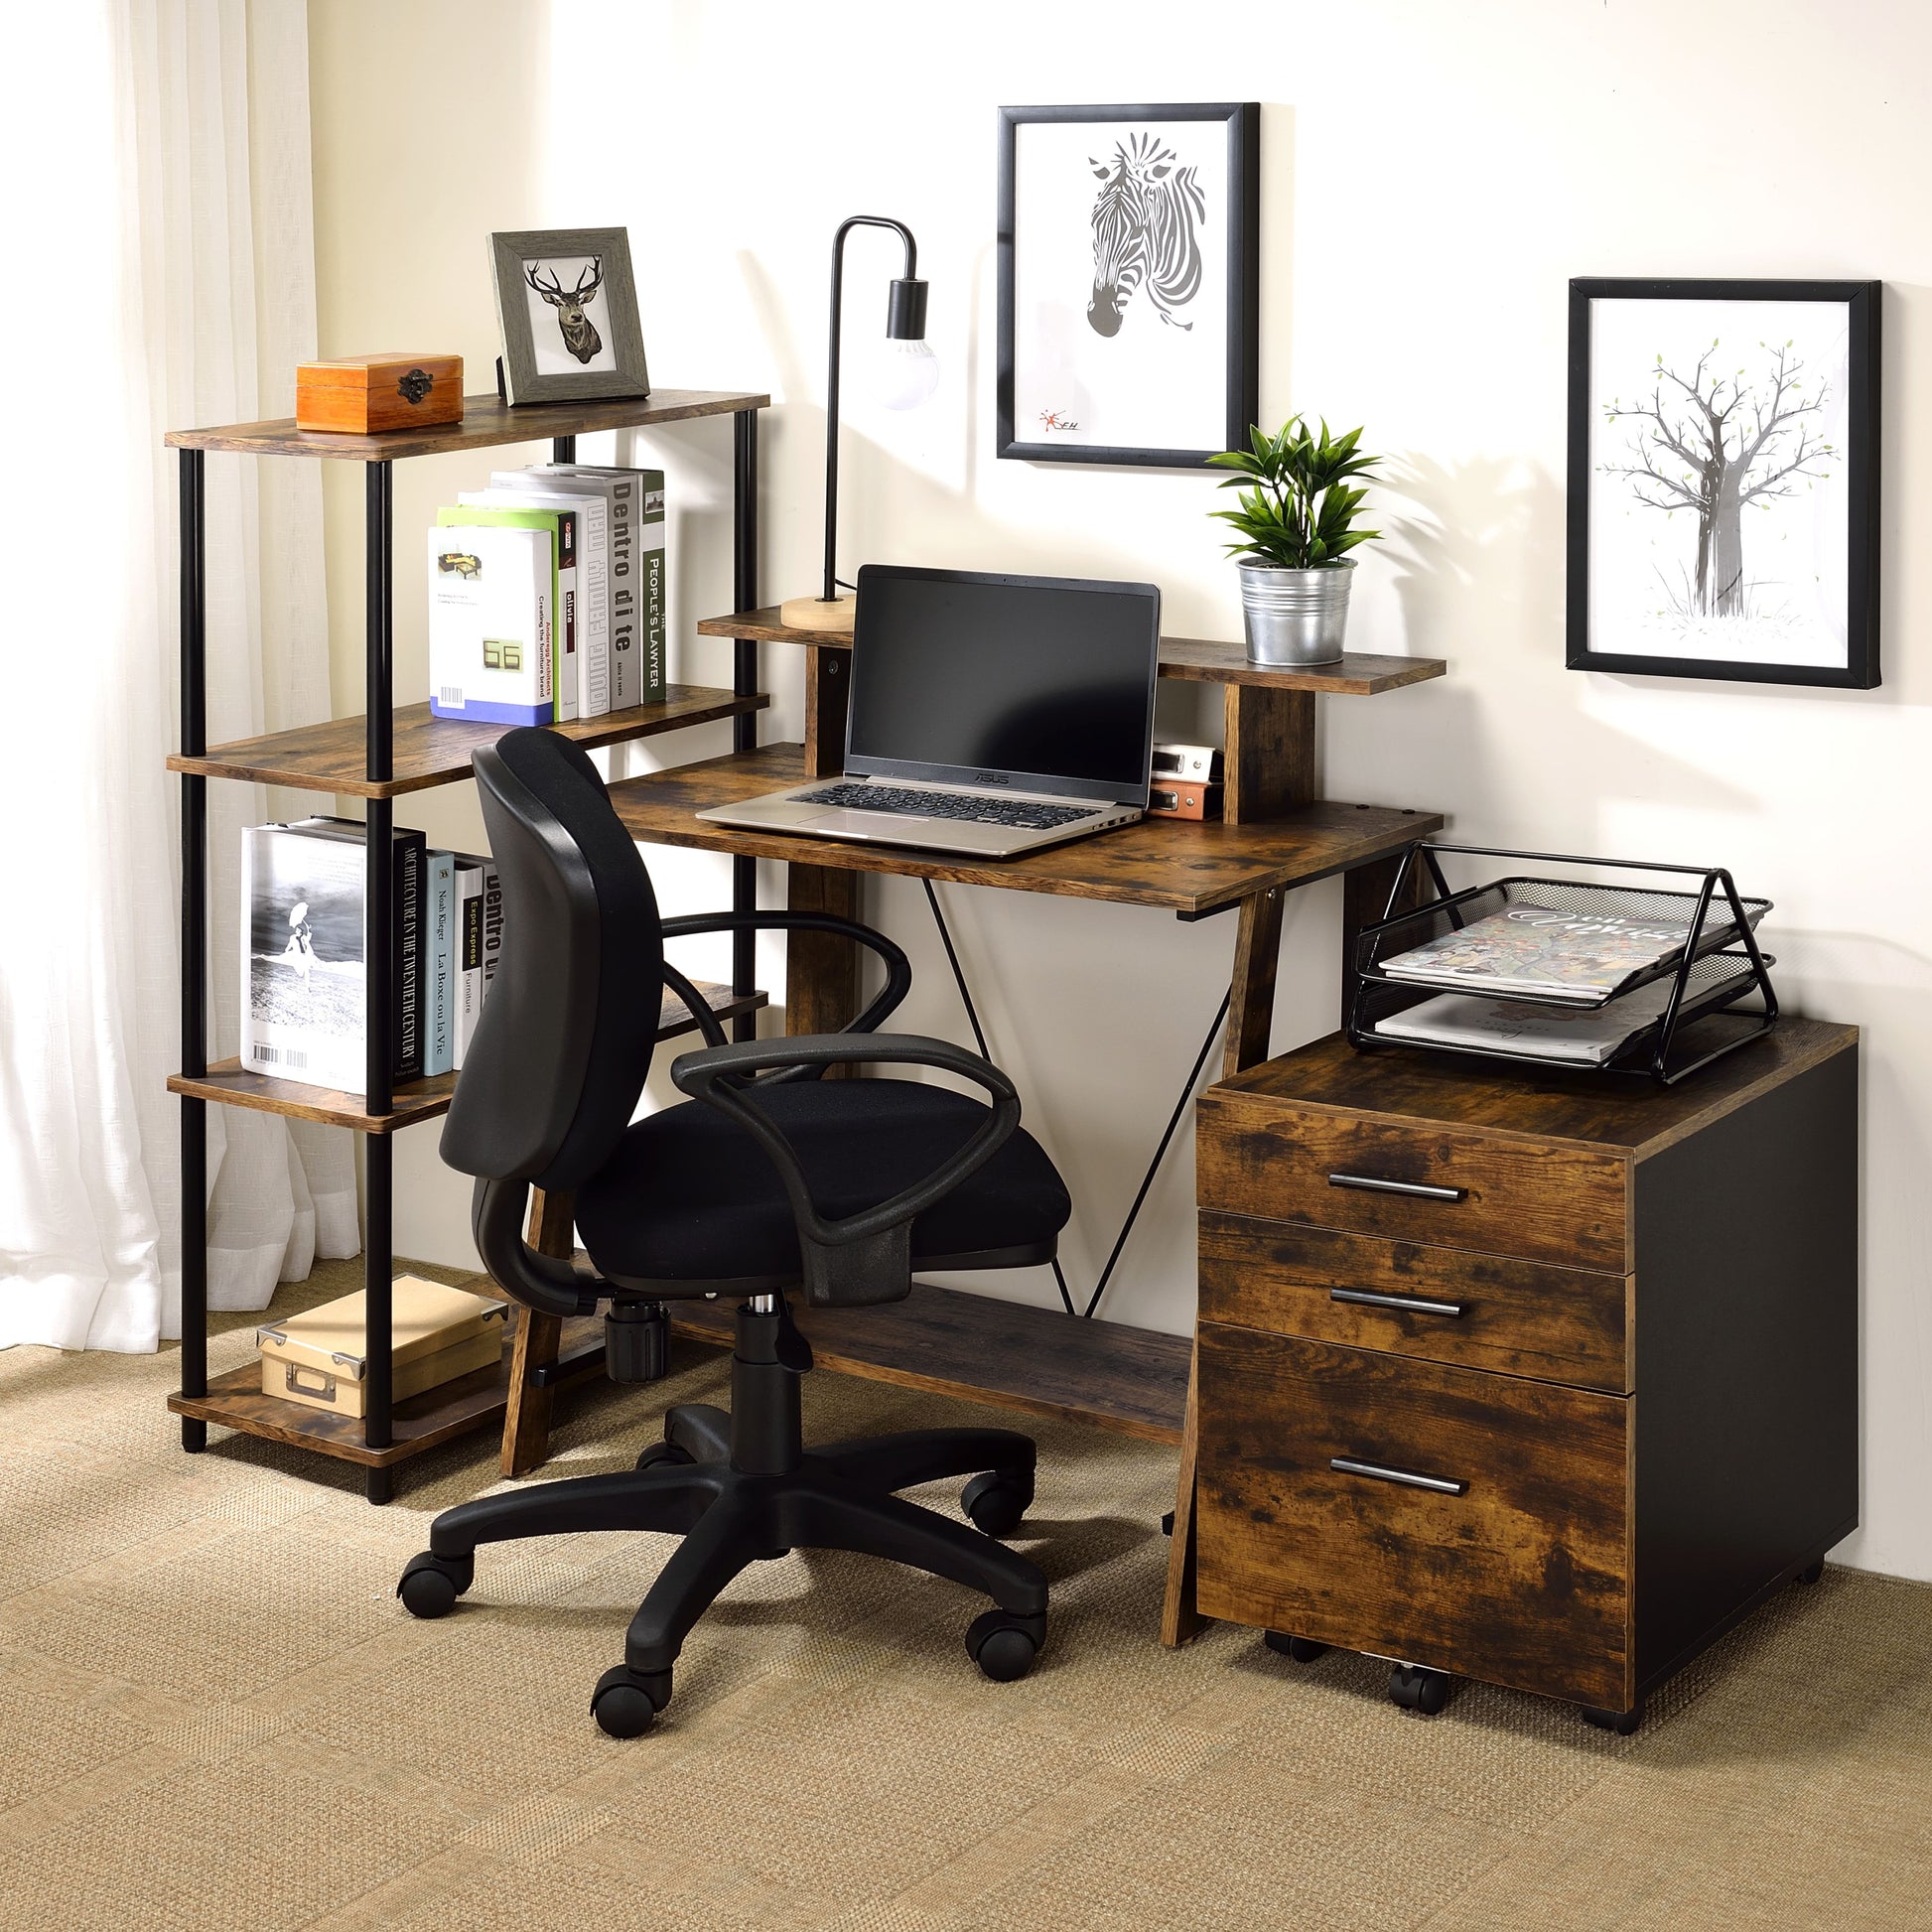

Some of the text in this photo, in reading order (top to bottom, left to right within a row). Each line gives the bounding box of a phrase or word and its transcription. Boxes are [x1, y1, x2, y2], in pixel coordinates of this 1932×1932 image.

[588, 504, 605, 552] MAN
[614, 483, 631, 577] Dentro
[589, 560, 606, 636] FAMILY
[615, 624, 632, 652] te
[649, 558, 659, 688] PEOPLE'S LAWYER
[975, 774, 1010, 784] ASUS
[403, 921, 416, 933] IN
[437, 914, 446, 940] Klieger
[470, 900, 479, 925] Expo
[403, 933, 416, 955] THE
[402, 954, 416, 1014] TWENTIETH
[437, 953, 447, 1055] La Boxe ou la Vie
[402, 1014, 415, 1059] CENTURY
